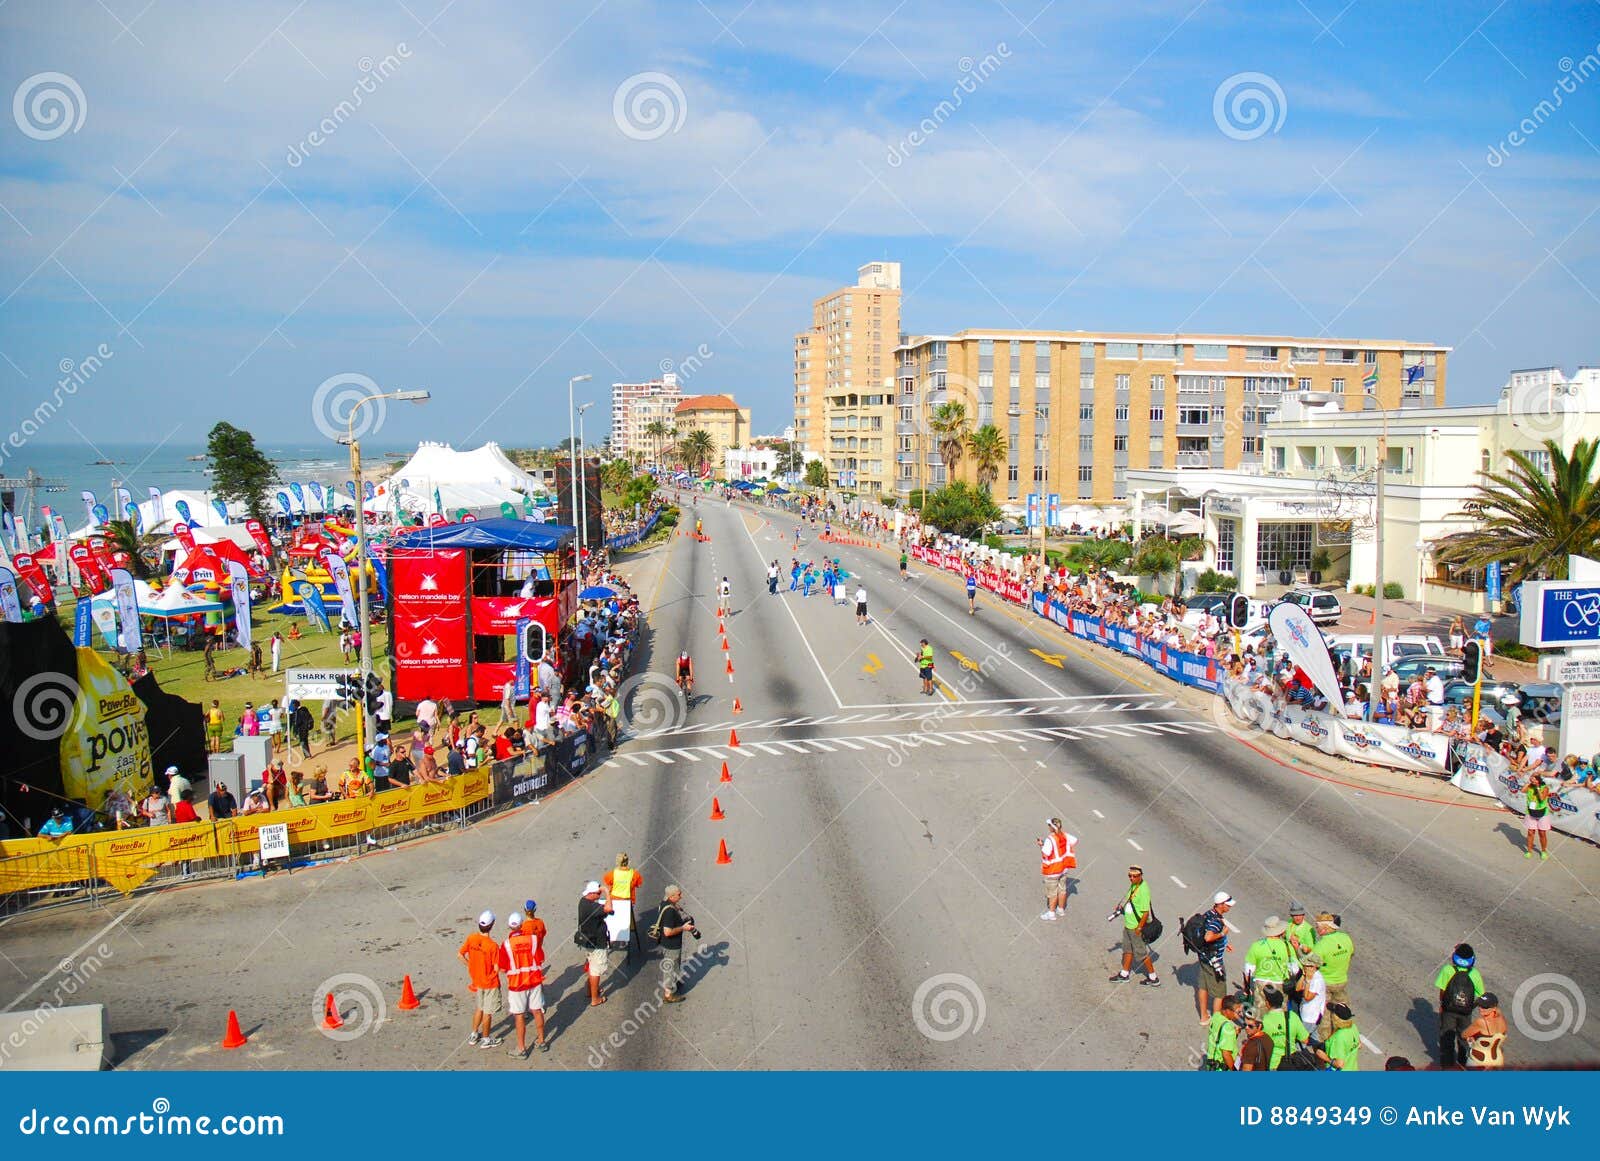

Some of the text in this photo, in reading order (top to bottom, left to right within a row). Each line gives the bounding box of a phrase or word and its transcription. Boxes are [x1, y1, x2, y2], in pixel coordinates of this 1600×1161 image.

[1554, 591, 1572, 600] THE
[450, 657, 462, 665] bay
[99, 694, 137, 714] PowerBar
[513, 774, 548, 796] CHEVROLET
[424, 789, 450, 801] PowerBar
[380, 799, 407, 812] PowerBar
[333, 809, 363, 823] PowerBar
[262, 825, 284, 834] FINISH
[169, 833, 204, 845] PowerBar
[263, 841, 285, 849] CHUTE
[110, 840, 146, 851] PowerBar
